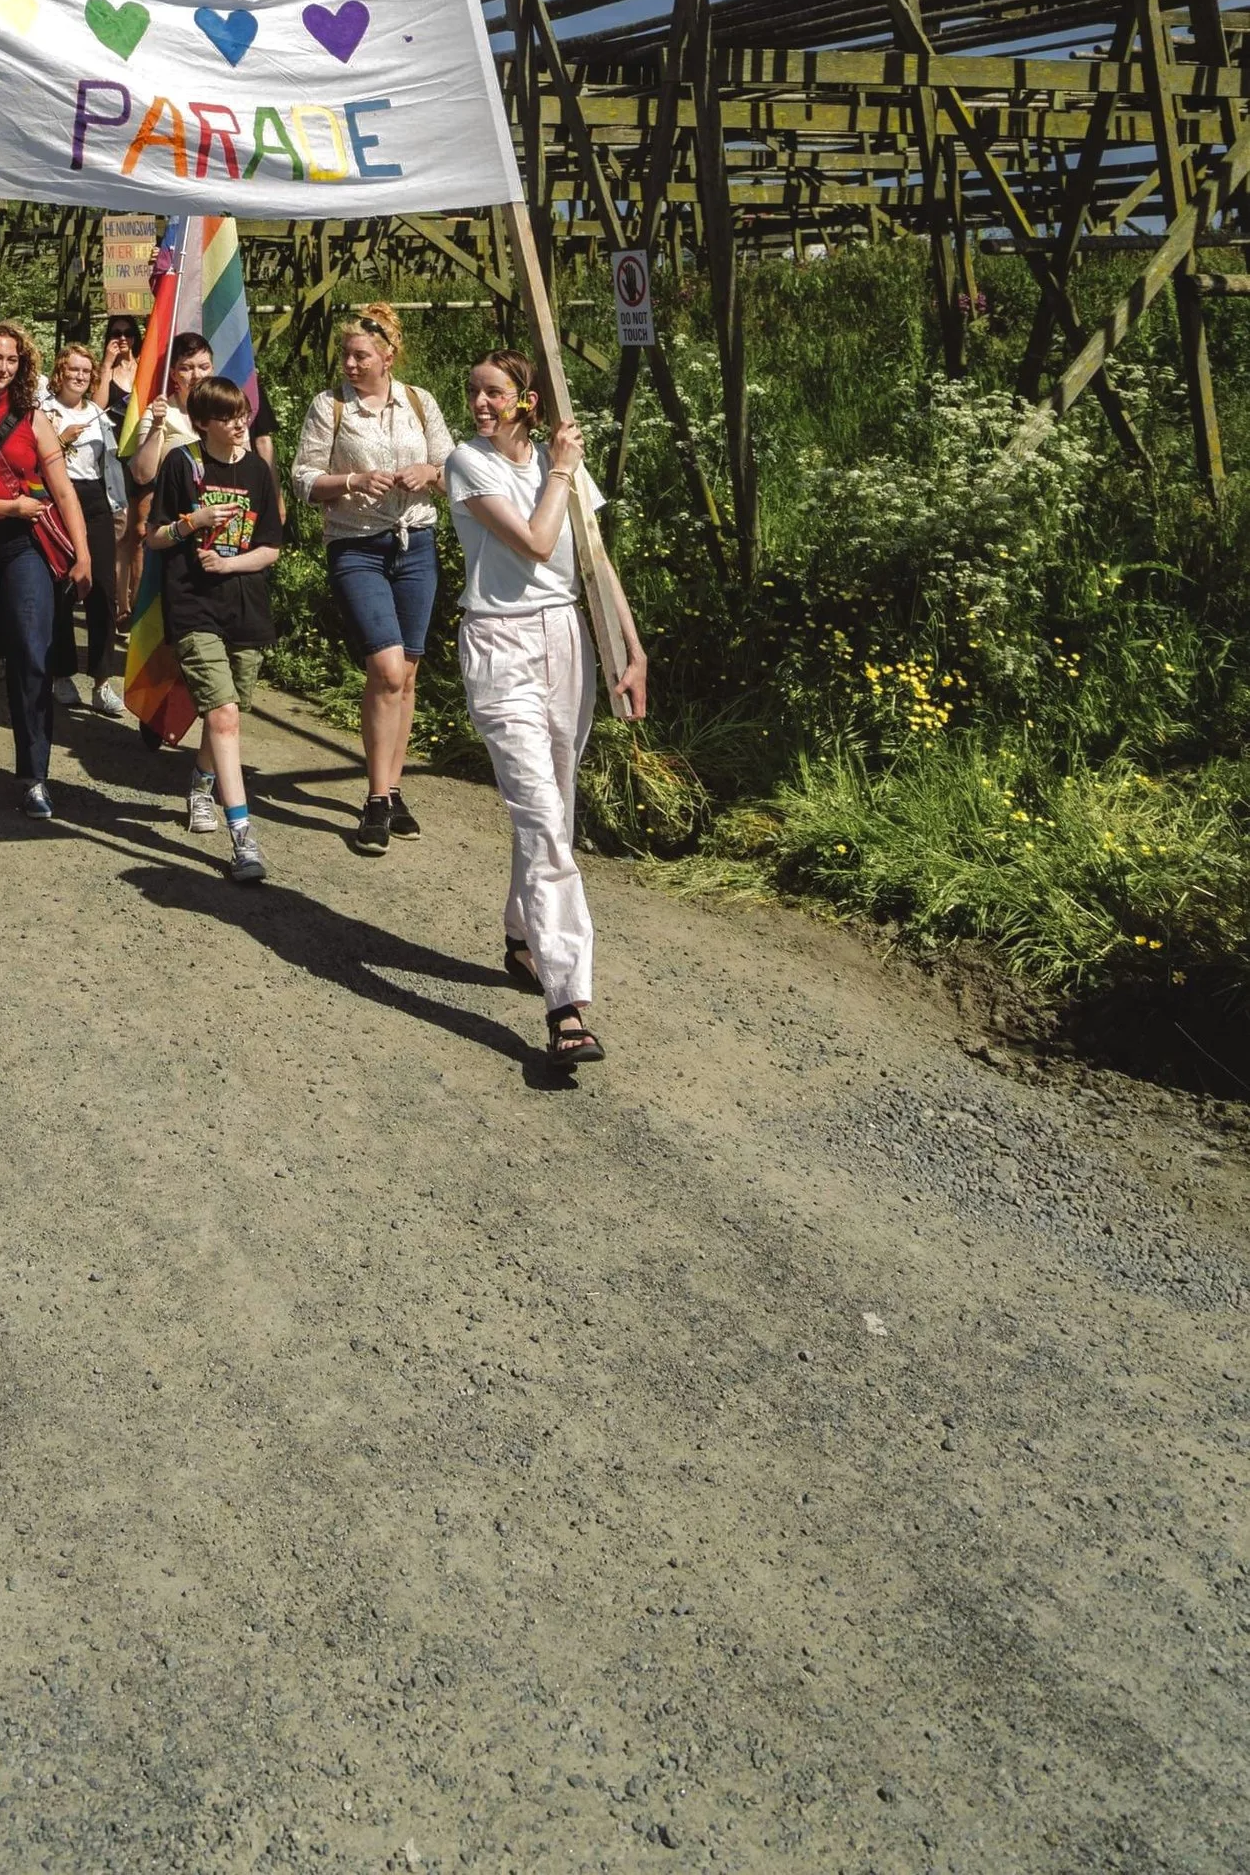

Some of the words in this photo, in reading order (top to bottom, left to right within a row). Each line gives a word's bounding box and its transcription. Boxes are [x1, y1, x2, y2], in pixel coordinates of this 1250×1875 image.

[70, 80, 403, 181] PARADE
[620, 312, 631, 324] DO
[632, 311, 648, 325] NOT
[623, 327, 648, 342] TOUCH
[202, 492, 250, 510] TURTLES
